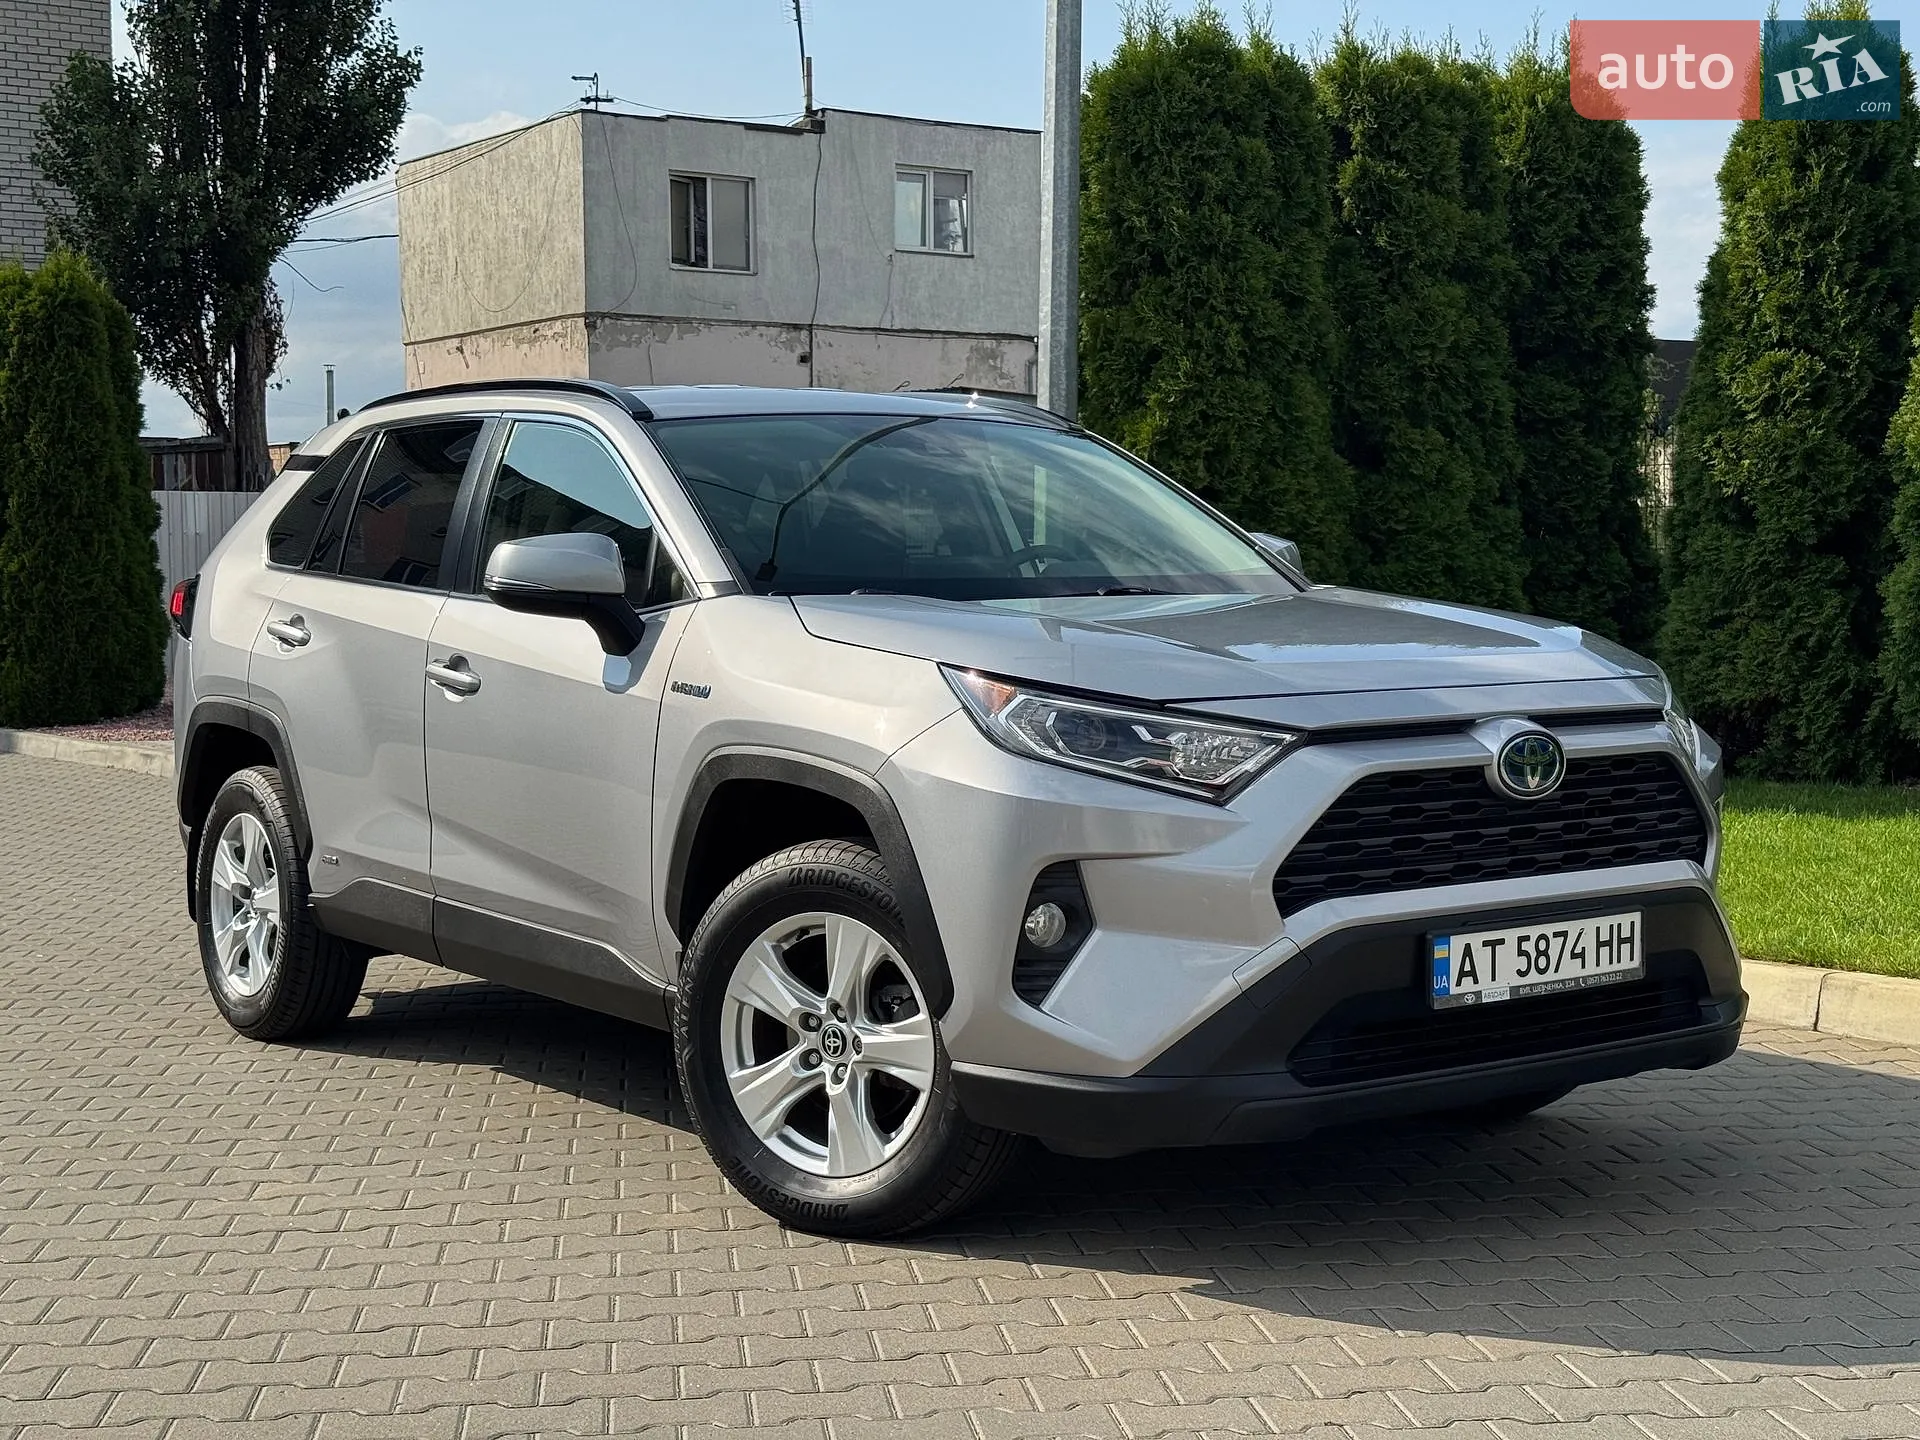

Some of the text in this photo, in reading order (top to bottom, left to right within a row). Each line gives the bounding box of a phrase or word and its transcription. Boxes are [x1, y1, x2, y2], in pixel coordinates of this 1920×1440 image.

[1455, 920, 1636, 987] AT 5874 HH
[1433, 975, 1449, 989] UA
